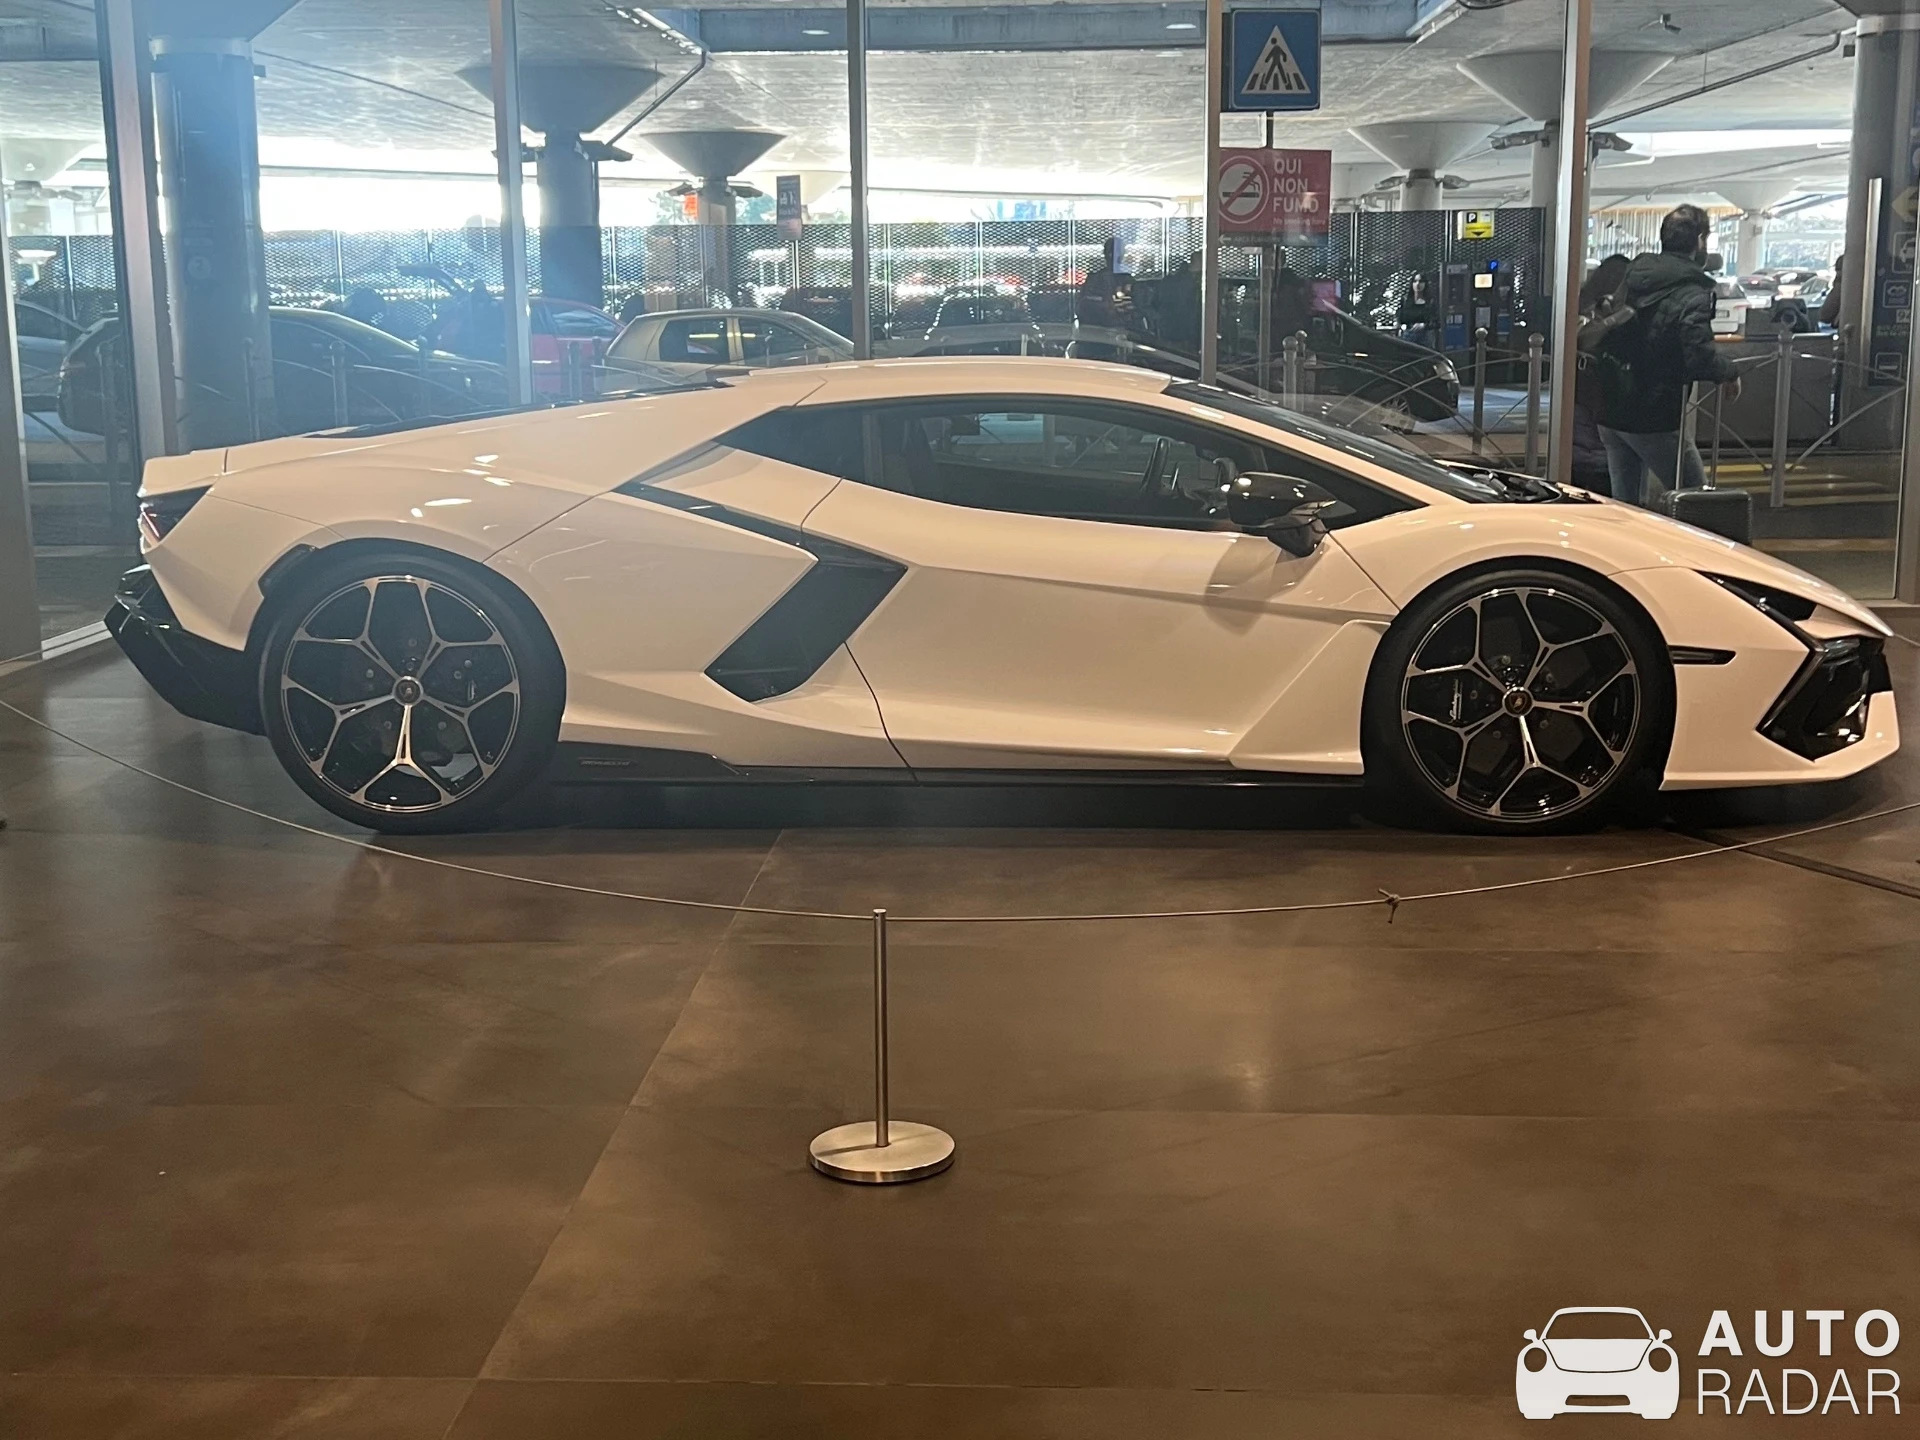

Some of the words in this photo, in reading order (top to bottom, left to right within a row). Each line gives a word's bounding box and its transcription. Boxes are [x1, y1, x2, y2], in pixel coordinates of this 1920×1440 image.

[1274, 158, 1301, 174] QUI
[1273, 178, 1308, 194] NON
[1273, 197, 1319, 213] FUMO
[1469, 213, 1476, 222] P
